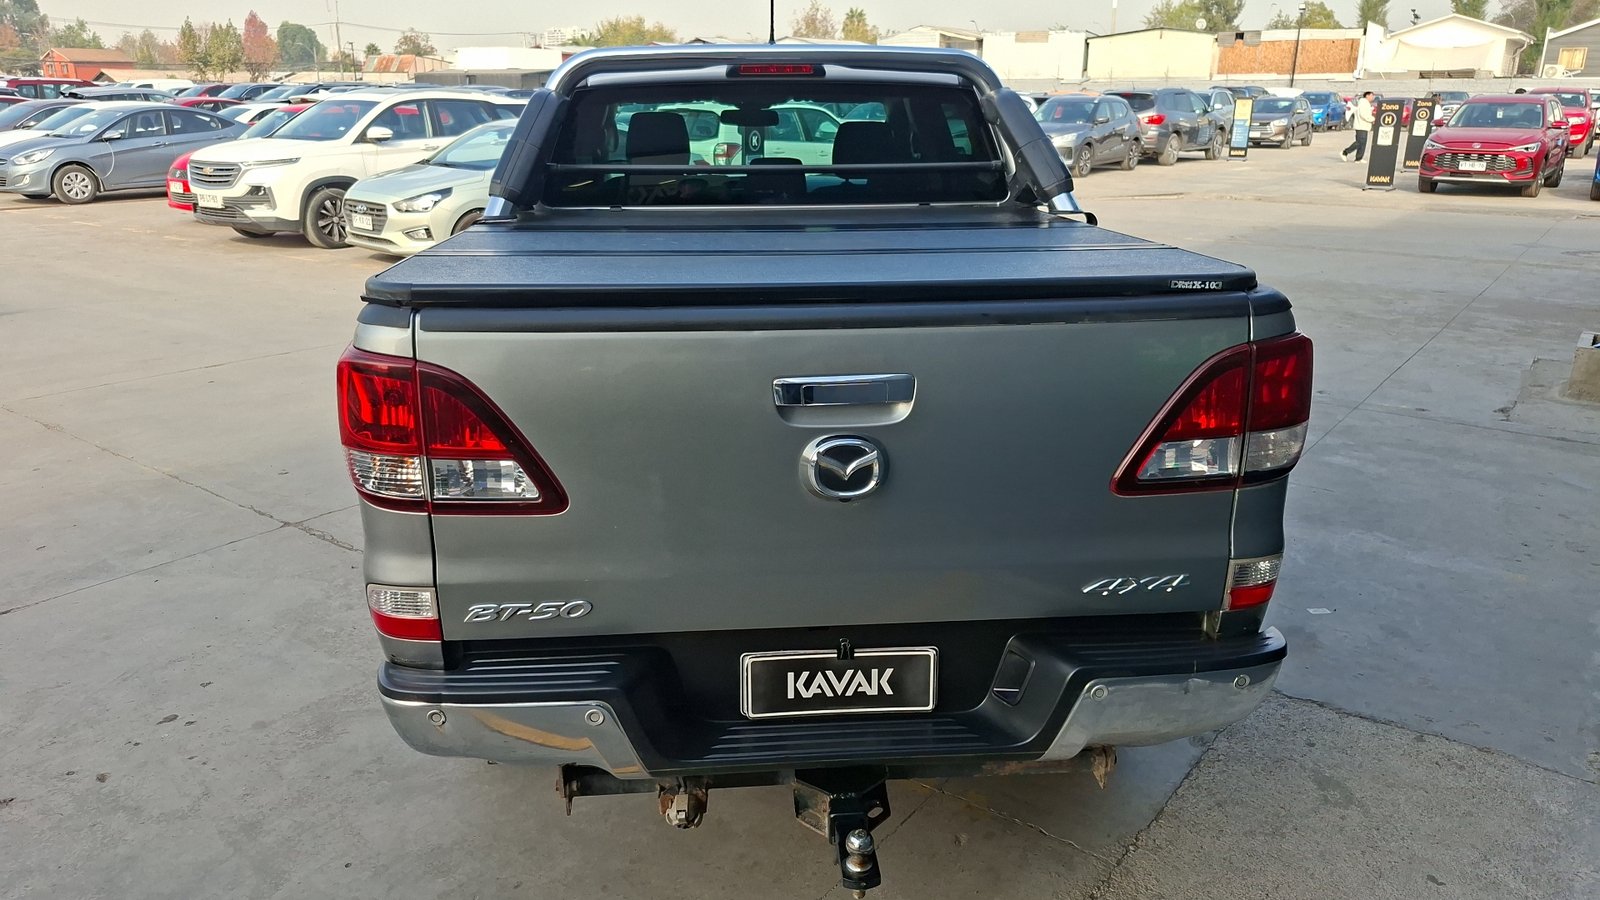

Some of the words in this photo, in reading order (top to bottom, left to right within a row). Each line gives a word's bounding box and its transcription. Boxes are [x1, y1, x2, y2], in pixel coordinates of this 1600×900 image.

[1384, 115, 1393, 124] H
[752, 135, 758, 147] K
[1369, 175, 1391, 183] KAVAK
[463, 599, 593, 623] BT-50
[786, 667, 895, 699] KAVAK
